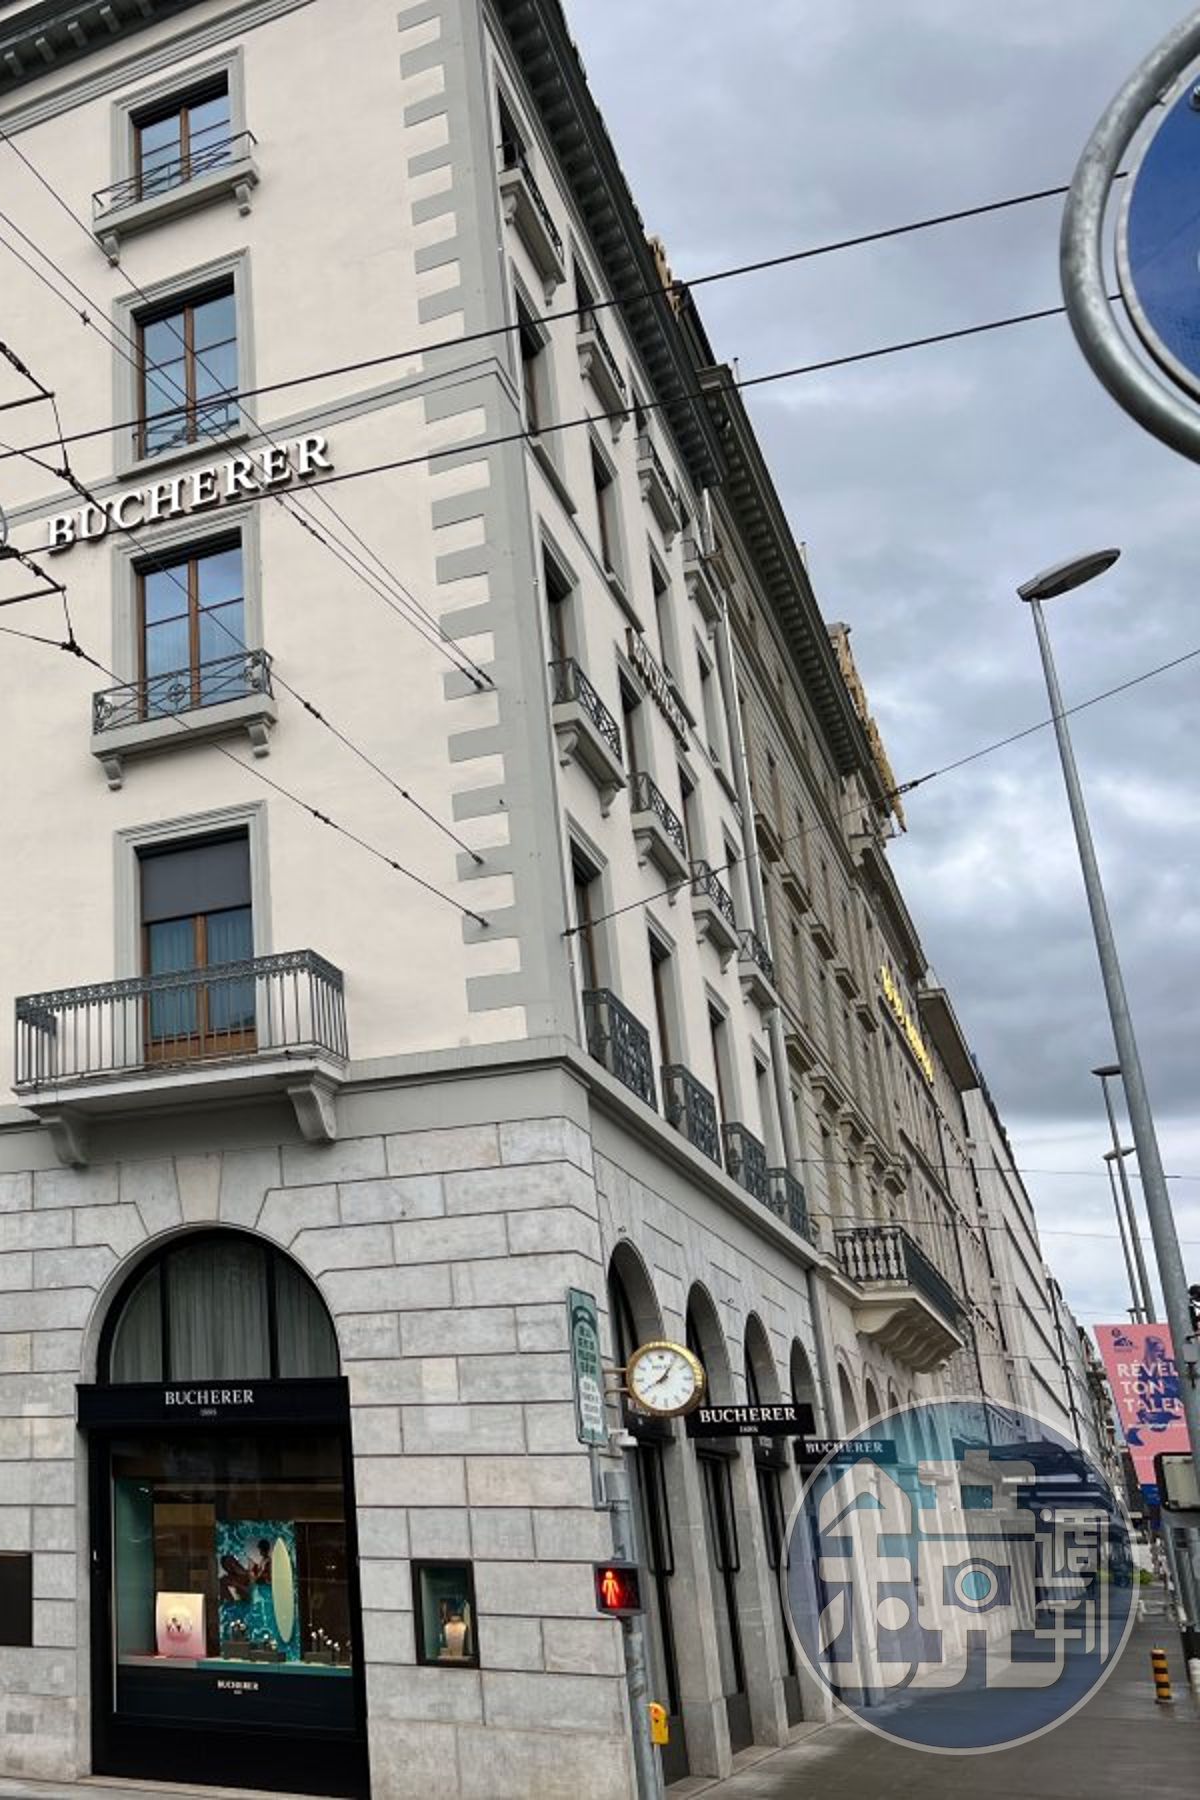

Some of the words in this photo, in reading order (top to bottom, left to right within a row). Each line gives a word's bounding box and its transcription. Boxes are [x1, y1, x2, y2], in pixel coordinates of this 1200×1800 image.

[48, 434, 335, 554] BUCHERER
[1120, 1380, 1165, 1395] TON
[165, 1389, 255, 1405] BUCHERER
[700, 1407, 798, 1423] BUCHERER
[805, 1441, 883, 1454] BUCHERER
